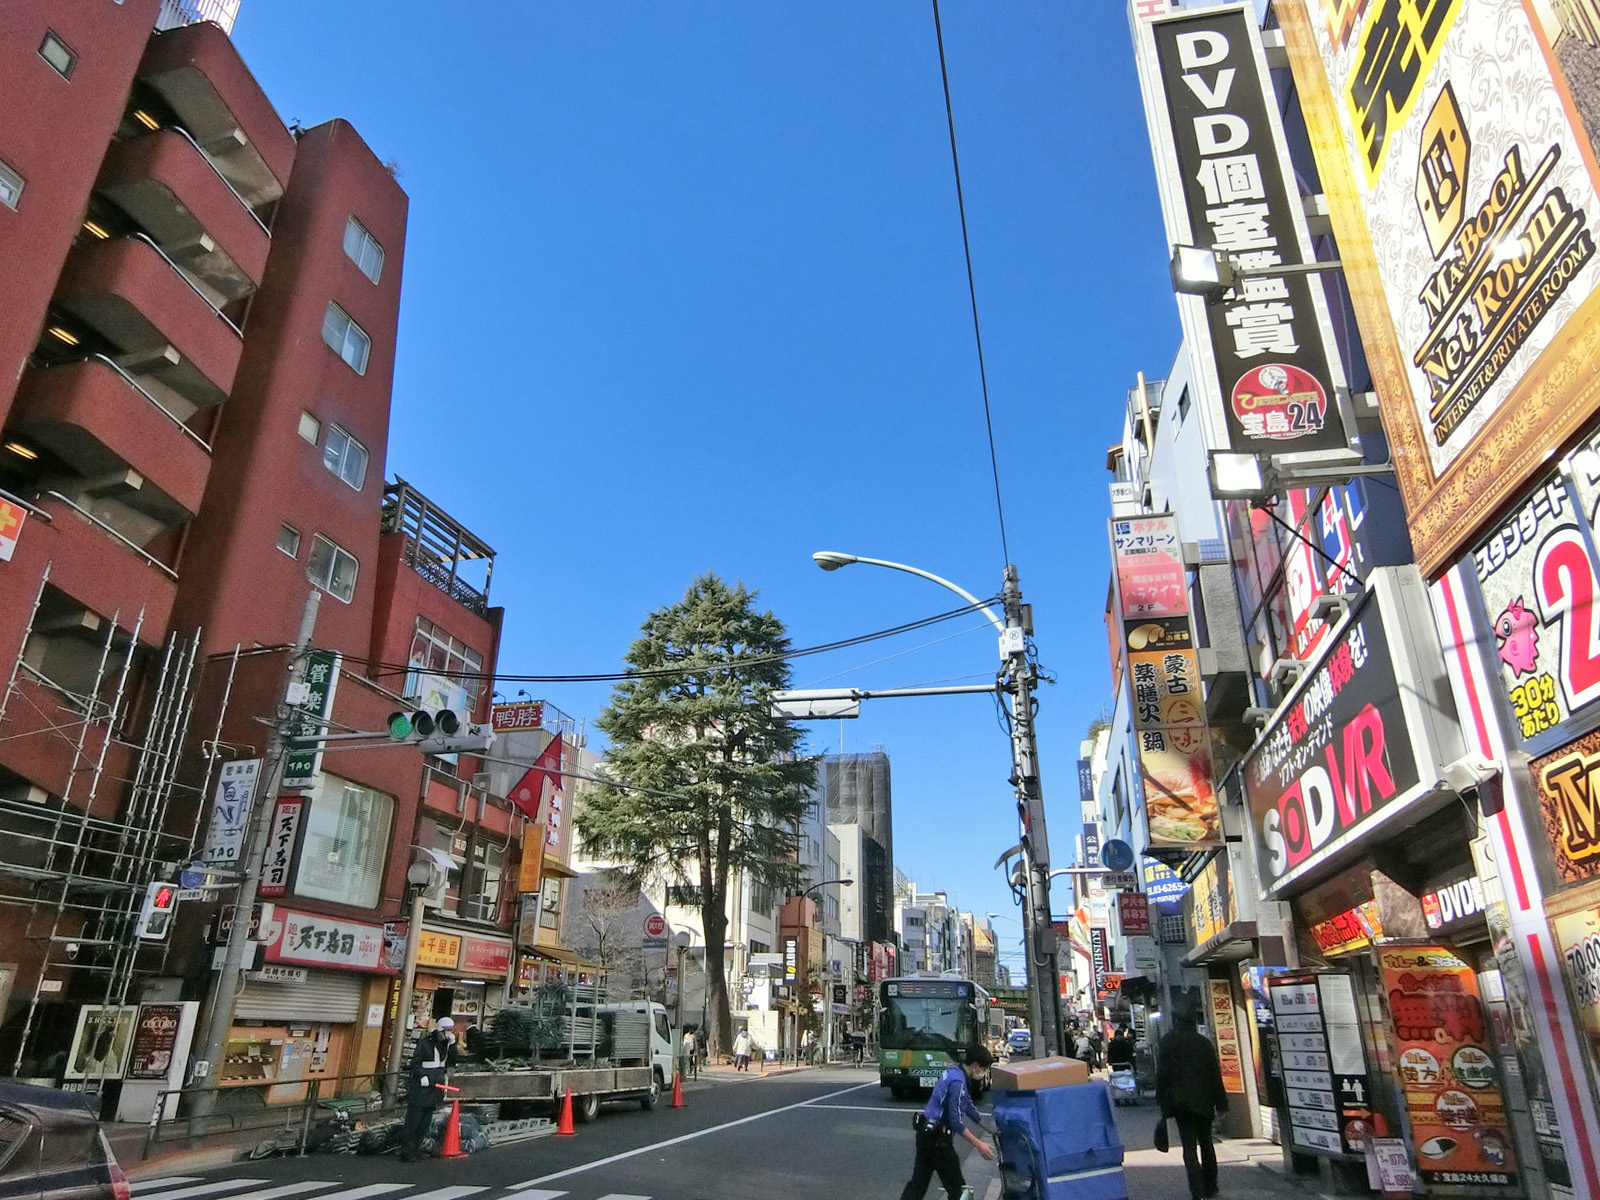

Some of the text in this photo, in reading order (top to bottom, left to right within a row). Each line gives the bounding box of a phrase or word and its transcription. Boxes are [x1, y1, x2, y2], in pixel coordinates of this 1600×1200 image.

[1422, 187, 1572, 400] Net Room
[1434, 229, 1597, 447] INTERNET&PRIVATE ROOM
[1240, 401, 1325, 436] 宝島24
[1115, 534, 1176, 549] サンマリーン
[1133, 521, 1168, 532] ホテル
[1476, 474, 1568, 584] スタンダード
[1164, 654, 1189, 694] 蒙古
[1134, 663, 1166, 752] 薬膳火鍋
[1511, 672, 1555, 718] 30分
[1520, 701, 1561, 741] あたり
[288, 761, 311, 772] TAO
[209, 847, 235, 860] TAO
[269, 815, 294, 885] 天下寿司
[1105, 874, 1136, 883] 歩行者優先
[294, 925, 355, 955] 天下寿司
[786, 940, 797, 980] DOUTOR
[142, 1018, 177, 1029] COCORO
